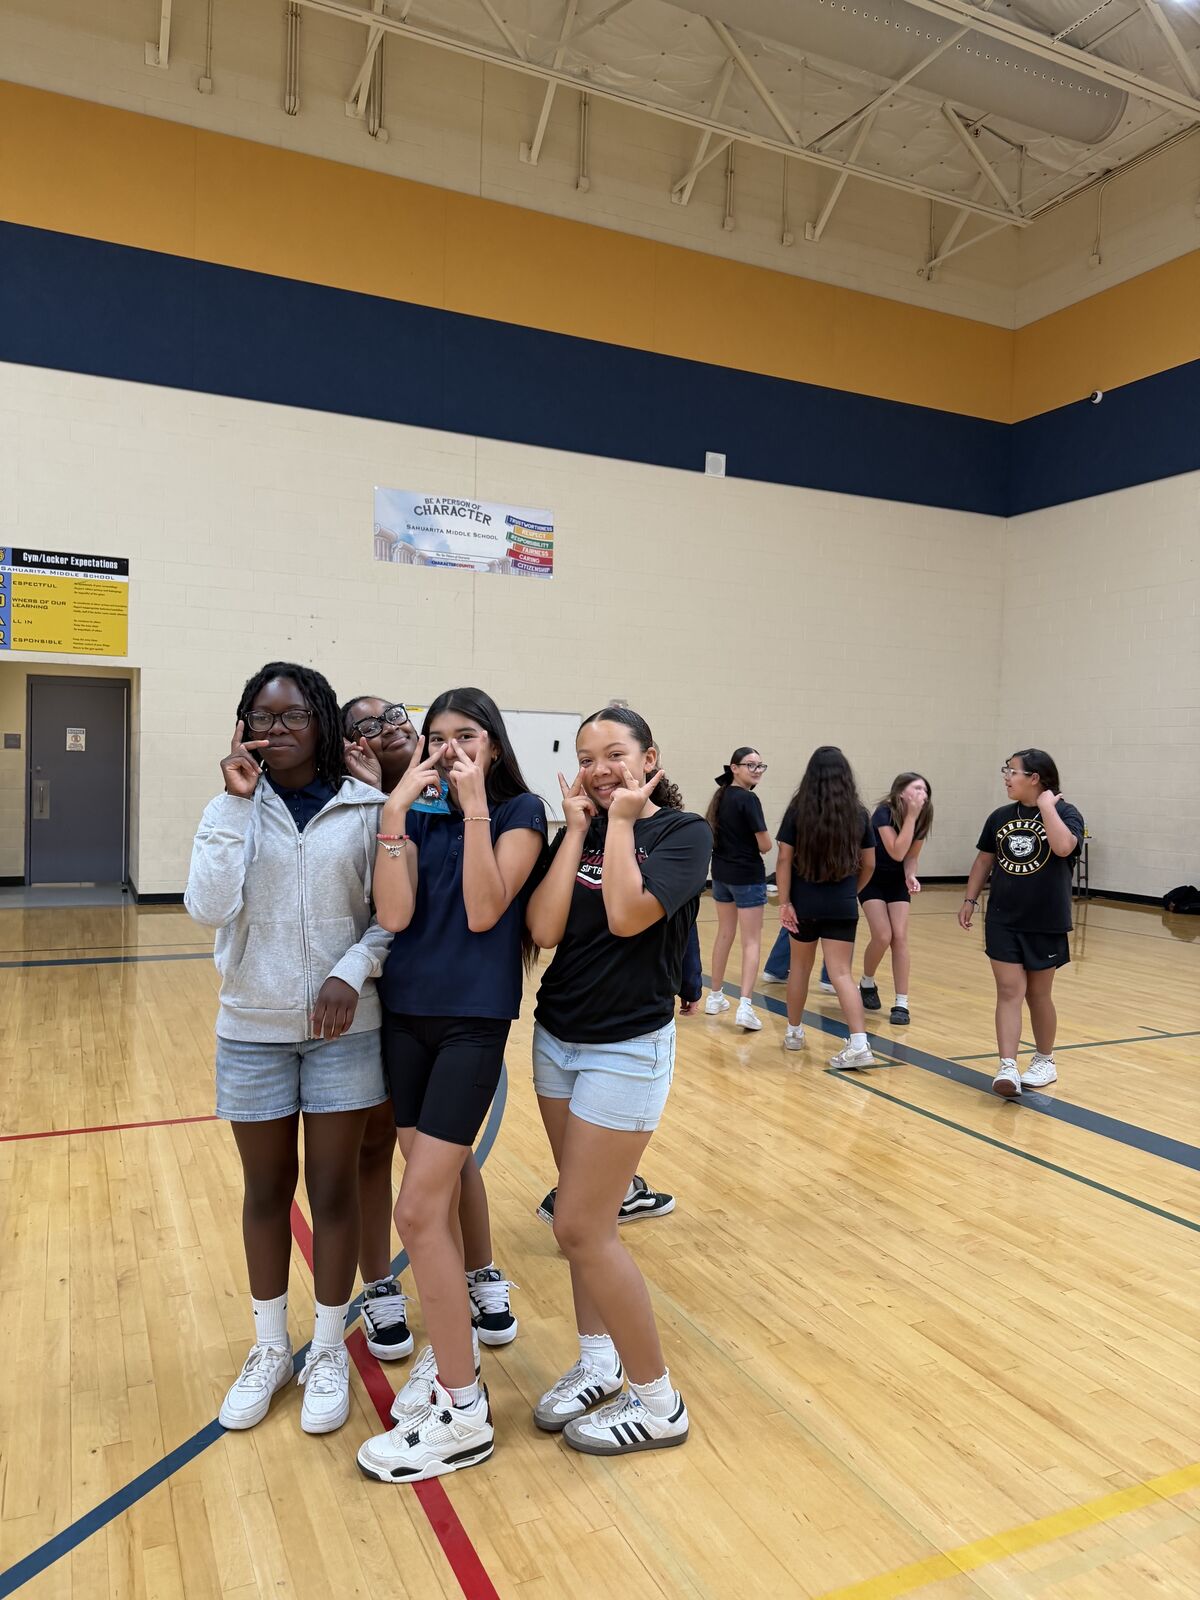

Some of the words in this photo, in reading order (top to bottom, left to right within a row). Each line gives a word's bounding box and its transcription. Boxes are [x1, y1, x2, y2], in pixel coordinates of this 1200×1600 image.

[442, 498, 470, 508] PERSON
[471, 503, 482, 511] OF
[413, 504, 492, 526] CHARACTER
[406, 524, 444, 534] SAHUARITA
[446, 529, 471, 537] MIDDLE
[473, 532, 498, 540] SCHOOL
[22, 551, 69, 565] Gym/Locker
[70, 556, 118, 569] Expectations
[519, 553, 540, 563] CARING
[0, 566, 46, 575] SAHUARITA
[49, 570, 79, 578] MIDDLE
[83, 572, 115, 580] SCHOOL
[1000, 858, 1040, 873] JAGUARS
